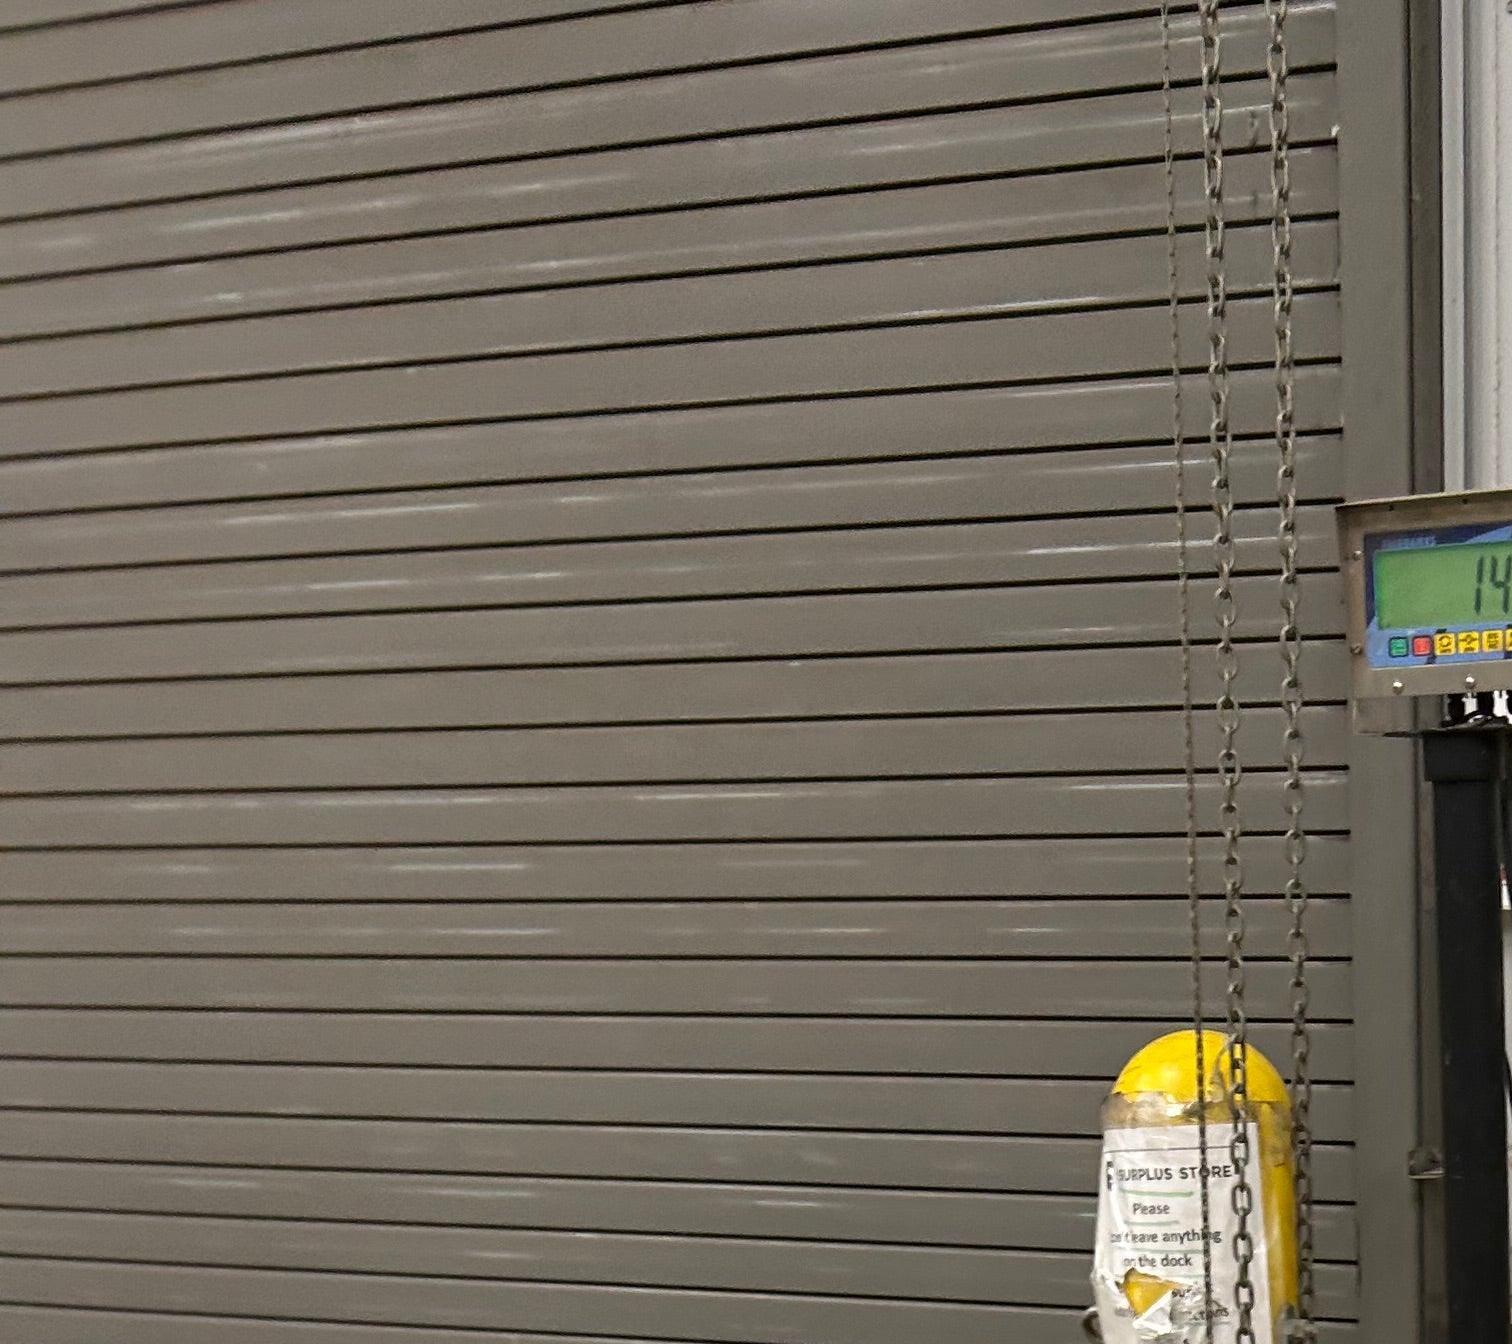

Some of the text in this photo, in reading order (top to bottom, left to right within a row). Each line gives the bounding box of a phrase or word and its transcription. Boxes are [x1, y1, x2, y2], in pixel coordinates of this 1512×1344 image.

[1116, 1166, 1173, 1182] SURPLUS
[1132, 1202, 1171, 1215] Please
[1162, 1228, 1223, 1245] anythg
[1138, 1254, 1156, 1267] the
[1160, 1254, 1192, 1267] dock
